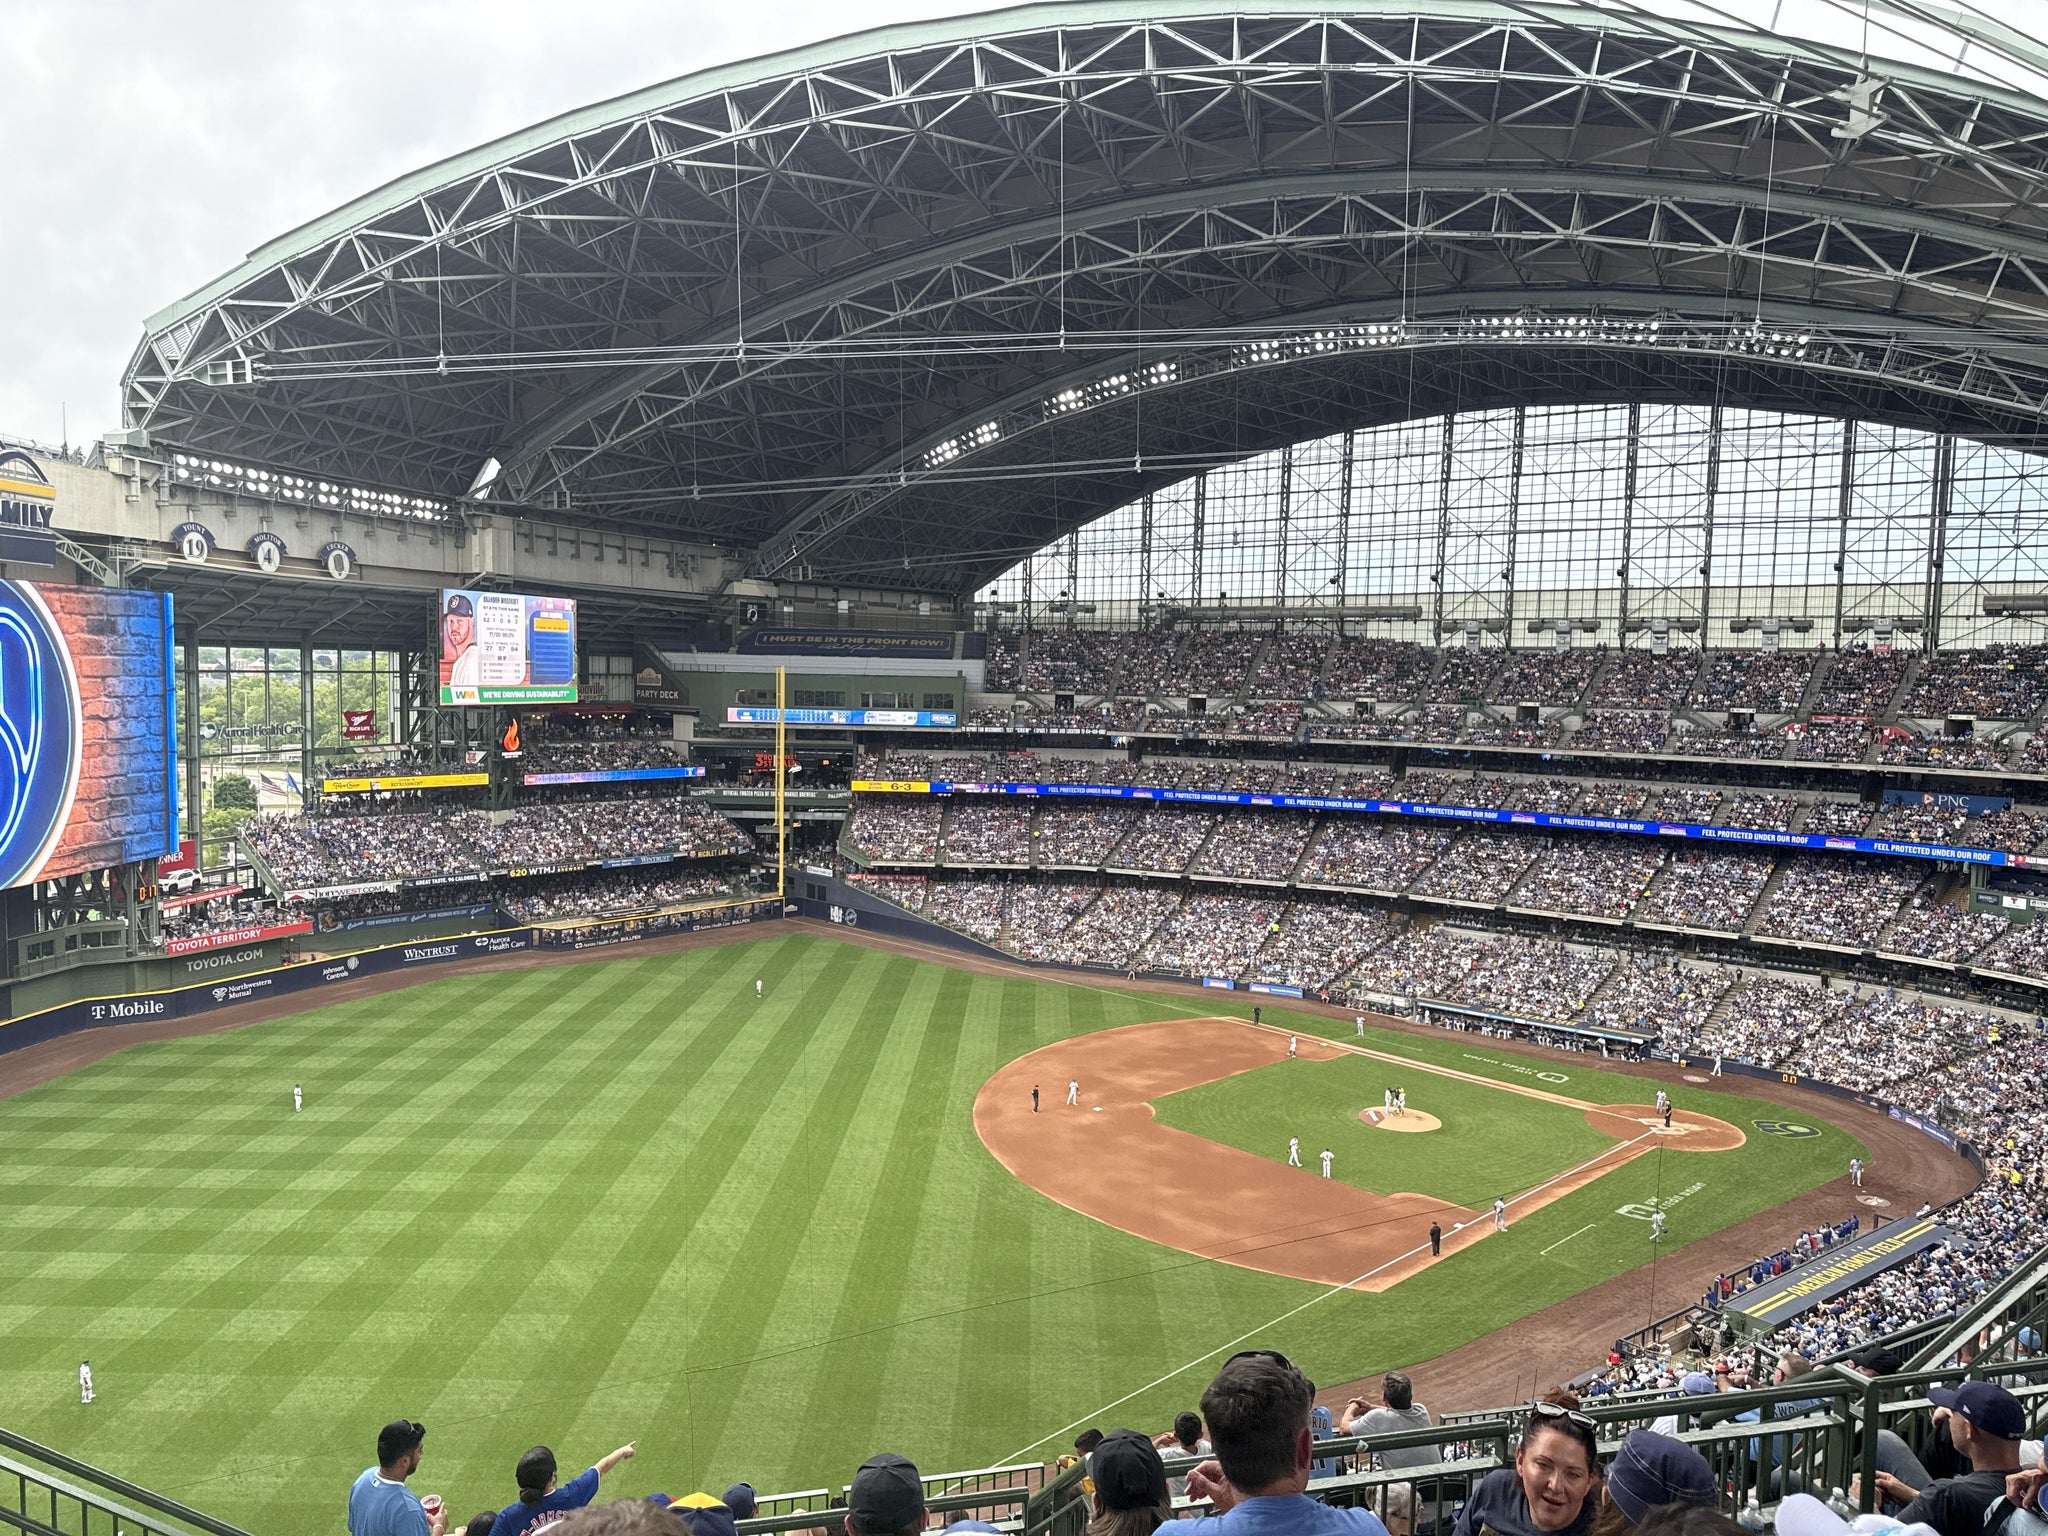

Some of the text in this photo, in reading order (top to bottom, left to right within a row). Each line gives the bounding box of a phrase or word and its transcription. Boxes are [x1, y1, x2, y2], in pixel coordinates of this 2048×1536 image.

[0, 499, 54, 529] MILY
[182, 523, 206, 535] YOUNT
[254, 534, 283, 547] MOLITOR
[186, 538, 204, 558] 19
[263, 547, 272, 564] 4
[502, 691, 526, 699] DRIVING
[636, 690, 679, 699] PARTY DECK
[219, 723, 305, 739] Aurora Health Care
[1224, 733, 1257, 741] COMMUNITY
[891, 783, 912, 791] 6-3
[1938, 795, 1970, 808] PNC
[1426, 807, 1453, 815] PROTECTED
[1563, 818, 1595, 827] PROTECTED
[1596, 820, 1615, 828] UNDER
[1702, 829, 1716, 837] FEEL
[1717, 830, 1752, 839] PROTECTED
[1754, 833, 1776, 841] UNDER
[1792, 836, 1808, 844] ROOF
[697, 850, 717, 858] NICOLET
[1874, 842, 1991, 861] FEEL PROTECTED UNDER OUR ROOF
[509, 868, 527, 878] 620
[528, 866, 556, 876] WTMJ
[415, 878, 431, 886] GREAT
[171, 929, 262, 953] TOYOTA TERRITORY
[489, 936, 511, 944] Aurora
[489, 940, 526, 951] Health Care
[404, 945, 457, 959] WINTRUST
[187, 948, 263, 972] TOYOTA.COM
[322, 966, 345, 976] Johnson
[326, 971, 349, 980] Controls
[228, 978, 272, 993] Northwestern
[228, 988, 252, 1000] Mutual
[109, 1000, 165, 1018] Mobile
[1786, 1264, 1847, 1297] AMERICAN
[1871, 1237, 1906, 1256] FIELD
[1312, 1416, 1328, 1430] RIO
[520, 1510, 569, 1536] -ARMS
